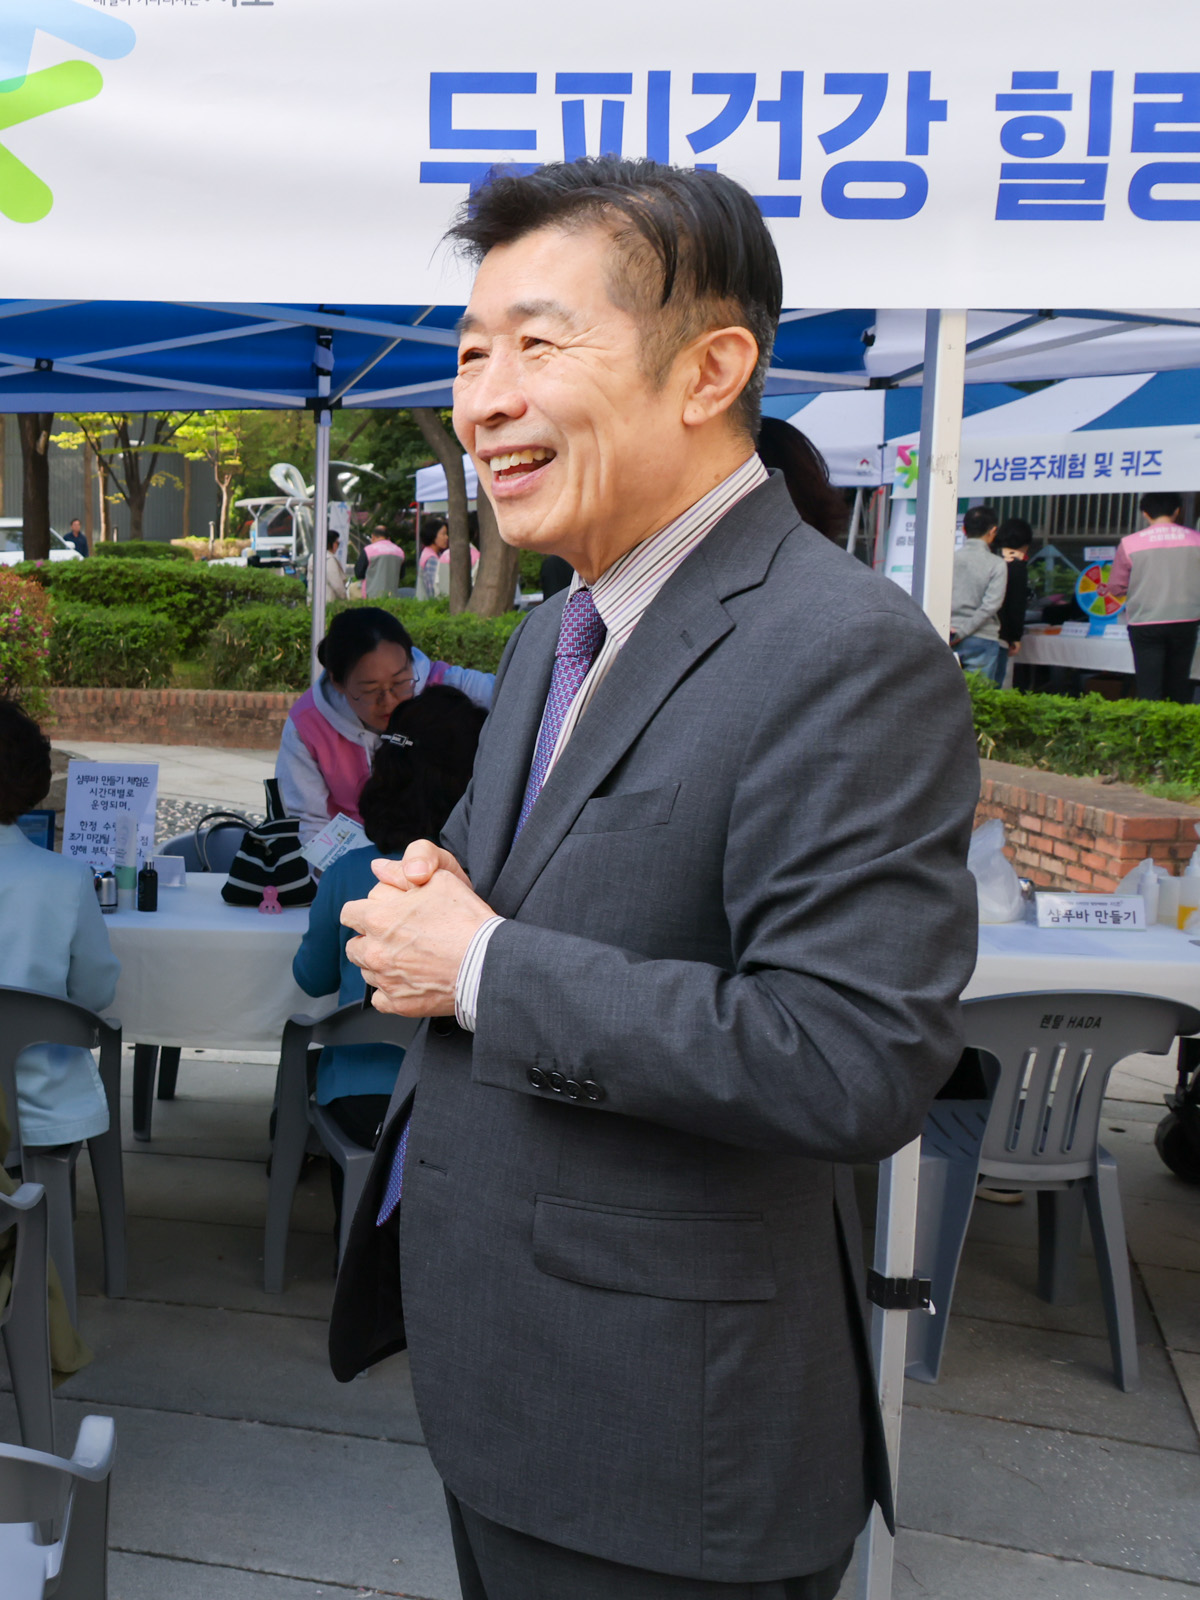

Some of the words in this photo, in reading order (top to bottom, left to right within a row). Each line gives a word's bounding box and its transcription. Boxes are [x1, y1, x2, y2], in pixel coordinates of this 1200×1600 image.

[419, 70, 948, 220] 두피건강
[973, 454, 1087, 482] 가상음주체험
[1093, 452, 1113, 478] 및
[1120, 450, 1163, 477] 퀴즈
[76, 774, 99, 785] 샴푸바
[101, 775, 124, 786] 만들기
[89, 788, 135, 799] 시간대별로
[79, 820, 97, 832] 한정
[68, 832, 84, 842] 조기
[70, 845, 88, 856] 양해
[1047, 909, 1090, 923] 샴푸바
[1094, 909, 1137, 925] 만들기
[1066, 1016, 1102, 1030] HADA
